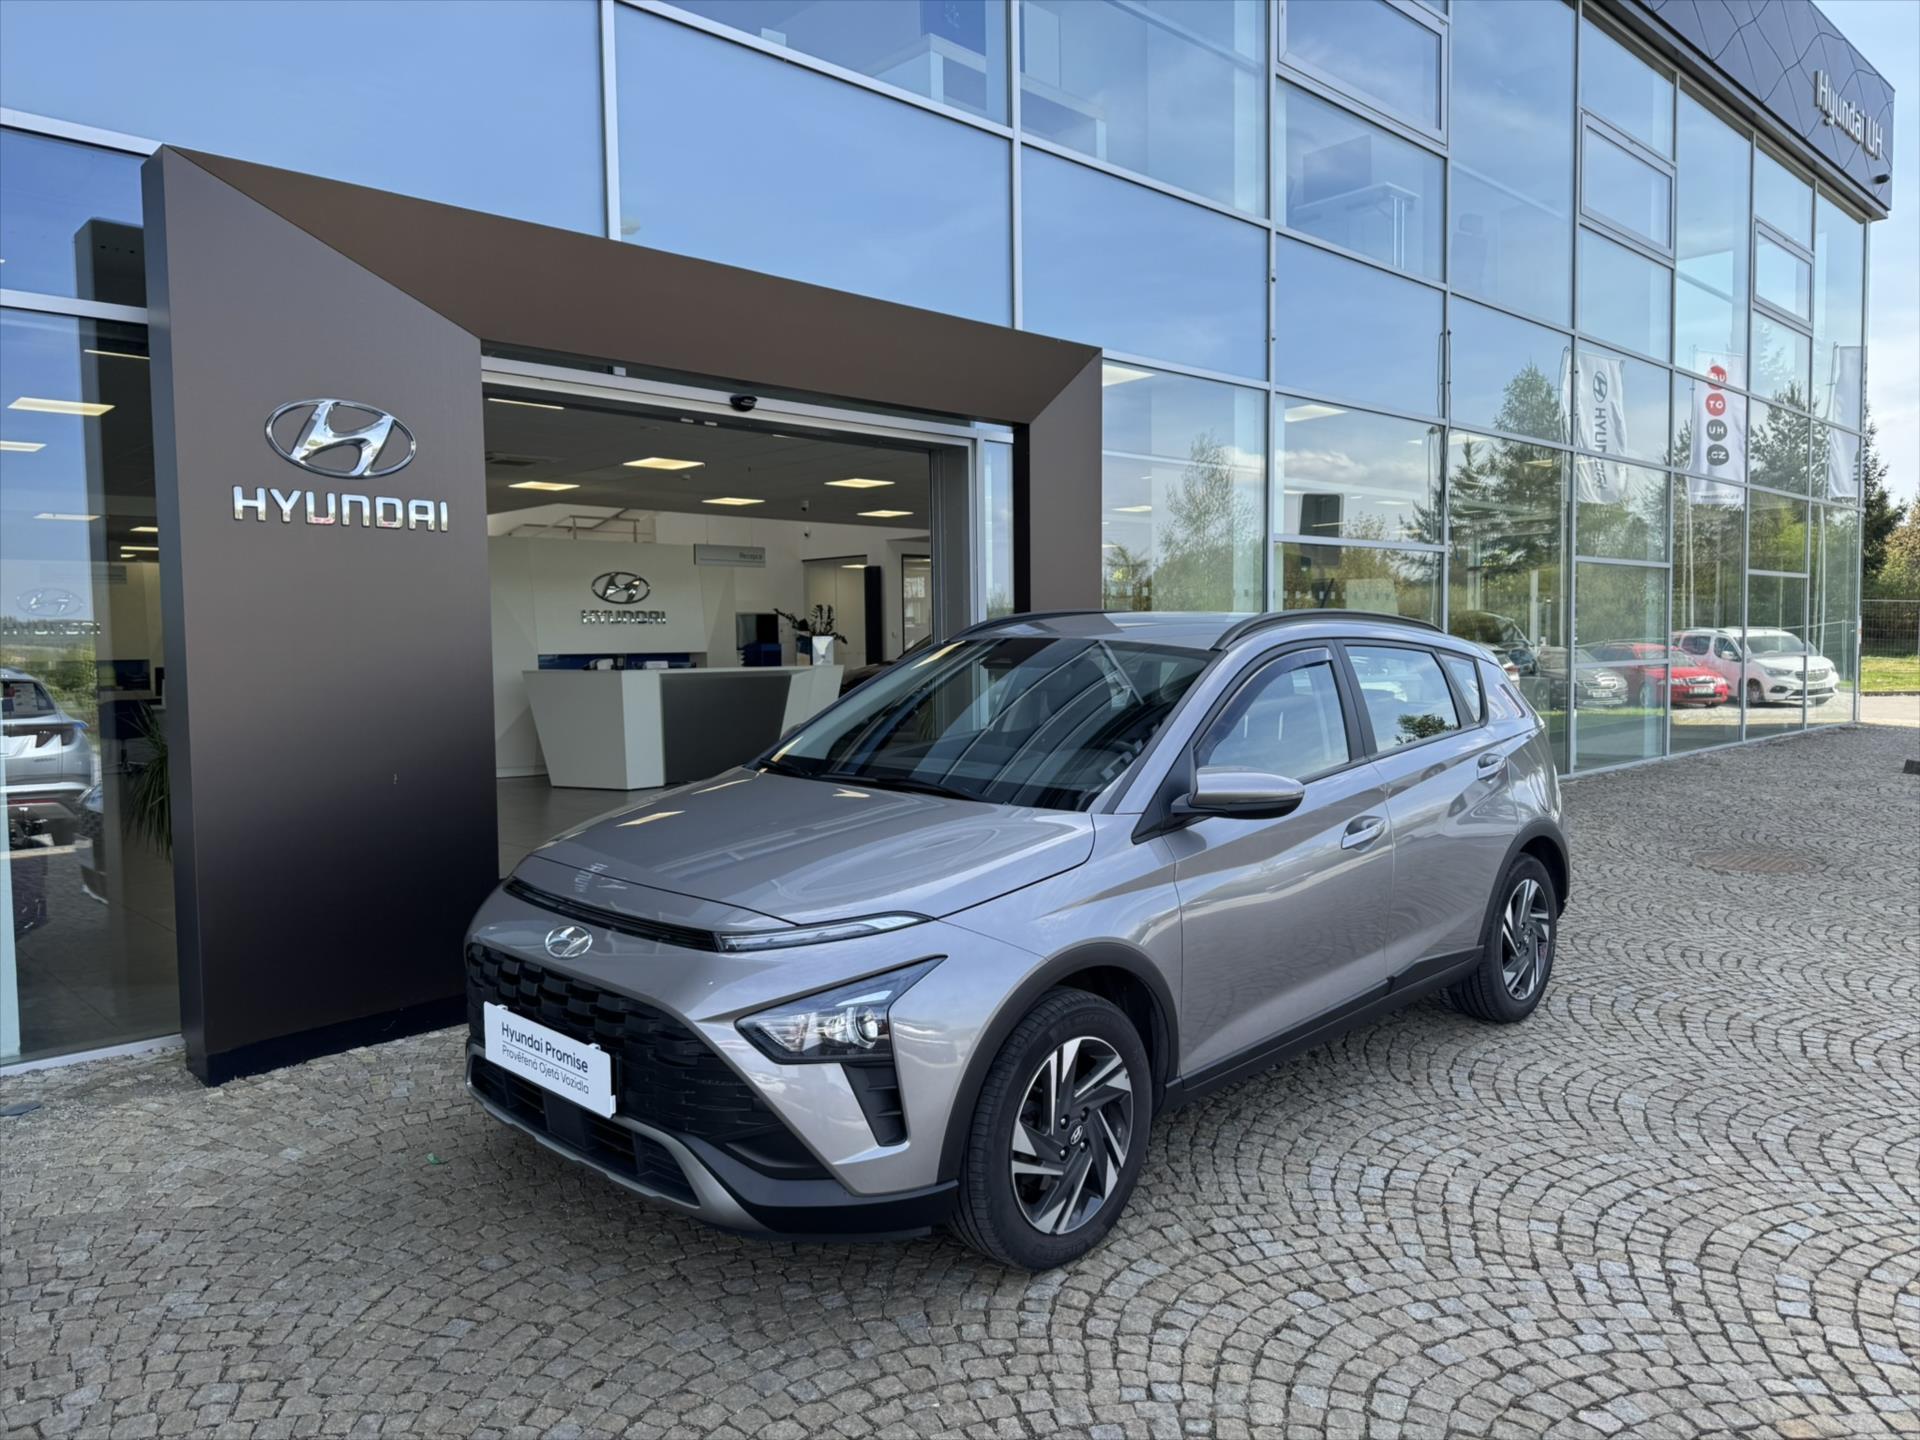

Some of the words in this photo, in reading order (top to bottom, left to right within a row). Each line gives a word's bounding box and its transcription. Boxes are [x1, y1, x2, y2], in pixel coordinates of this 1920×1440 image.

[1815, 70, 1865, 145] Hyundai
[1866, 115, 1883, 160] UH
[1709, 401, 1724, 409] TO
[1708, 425, 1724, 434] UH
[232, 485, 449, 532] HYUNDAI
[581, 609, 666, 624] HYUNDAI
[502, 1021, 543, 1053] Hyundai
[545, 1041, 589, 1074] Promise
[502, 1044, 538, 1071] Prověřená
[539, 1062, 560, 1081] Ojetá
[560, 1072, 590, 1095] Vozidla
